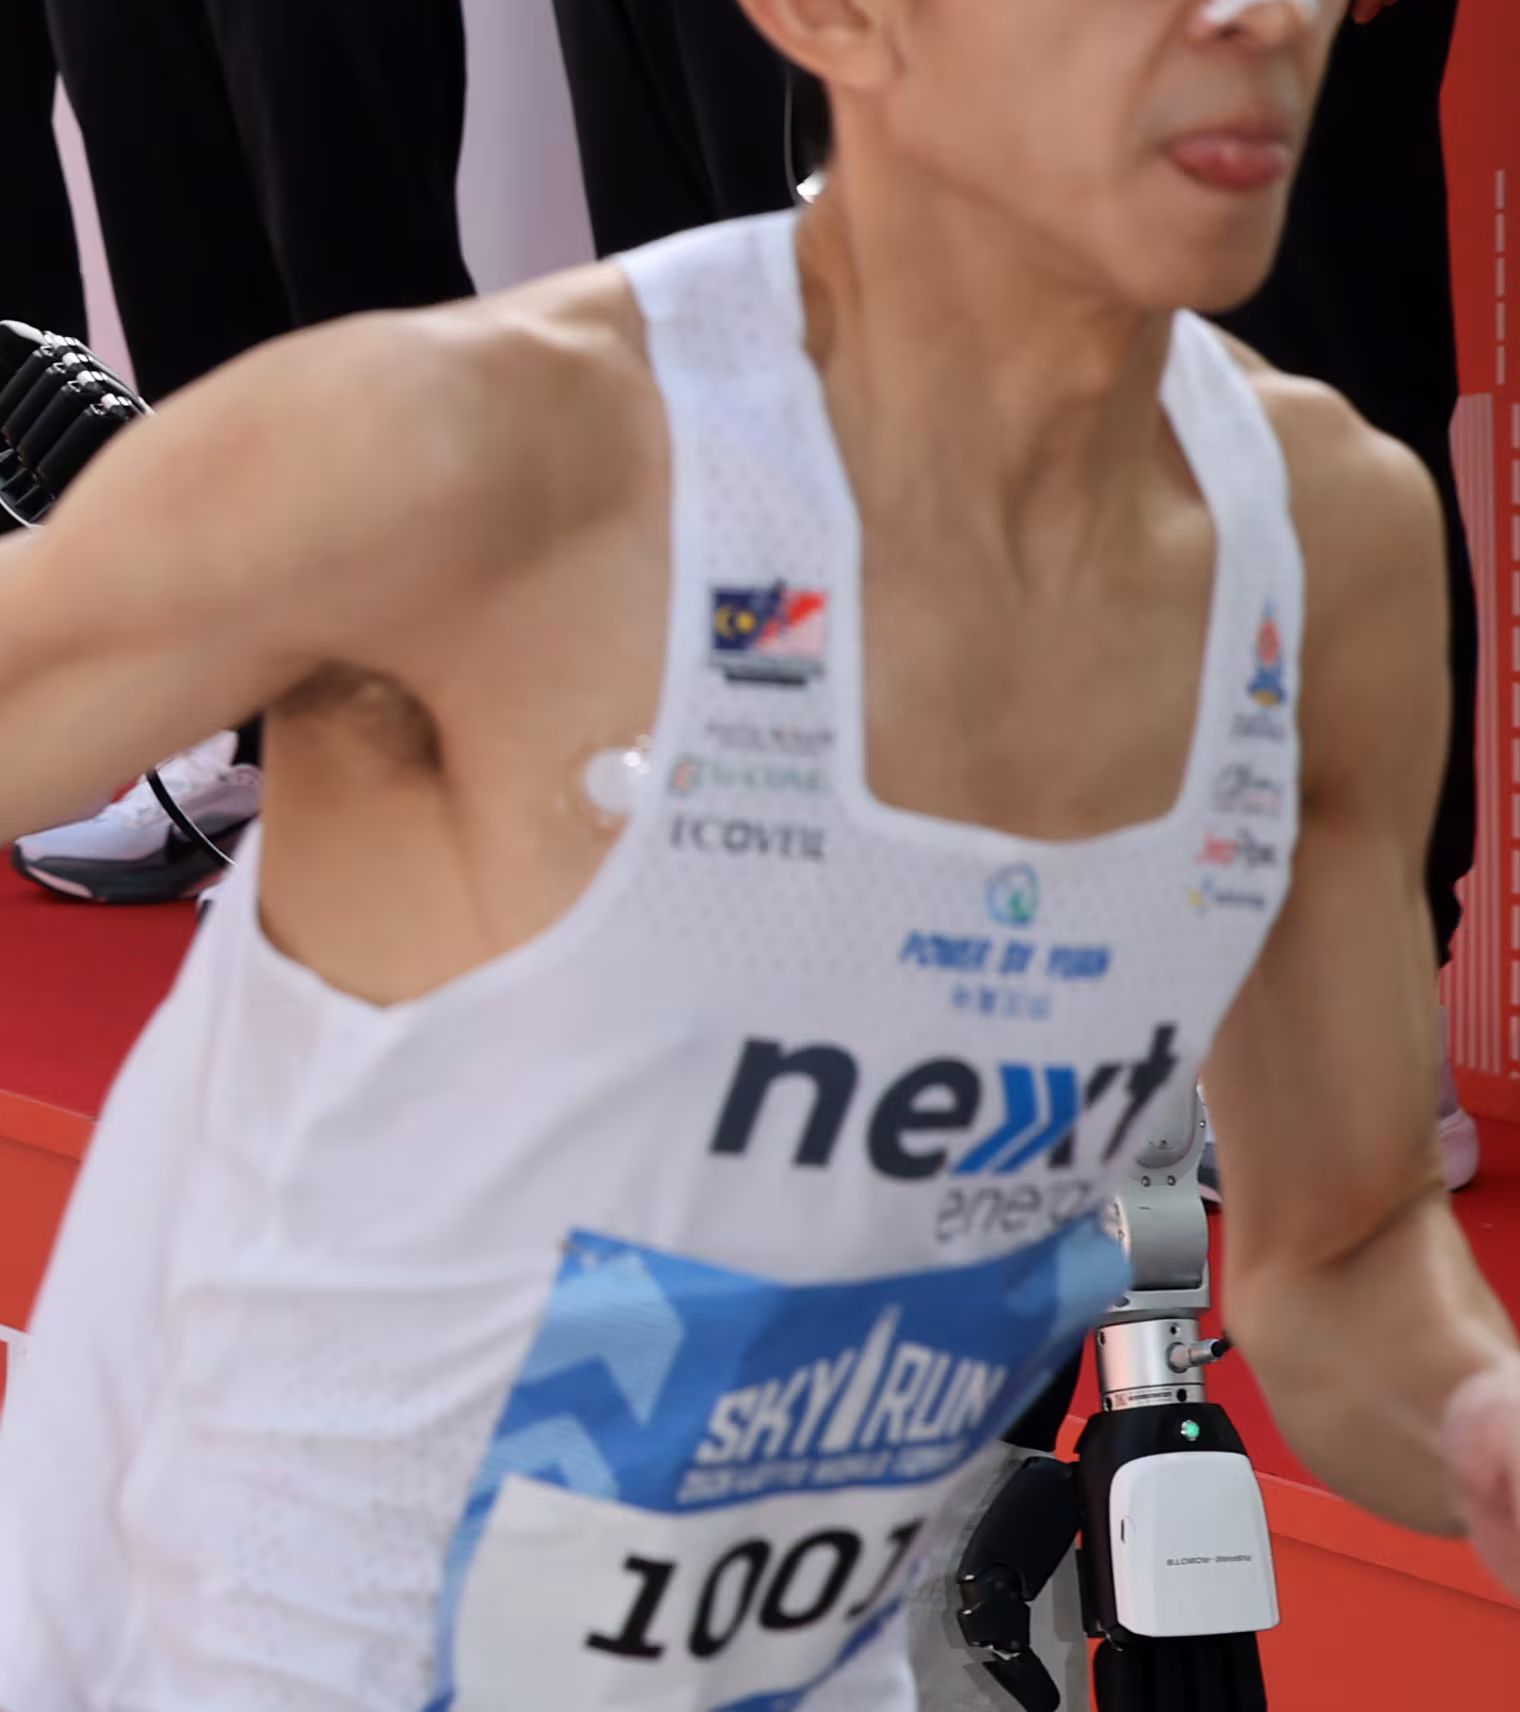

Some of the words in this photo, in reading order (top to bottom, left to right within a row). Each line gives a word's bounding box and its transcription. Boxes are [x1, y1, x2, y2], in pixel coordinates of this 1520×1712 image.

[708, 1021, 1177, 1180] next
[696, 1346, 857, 1465] SKY
[861, 1342, 1007, 1450] RUN
[583, 1517, 926, 1661] 1001
